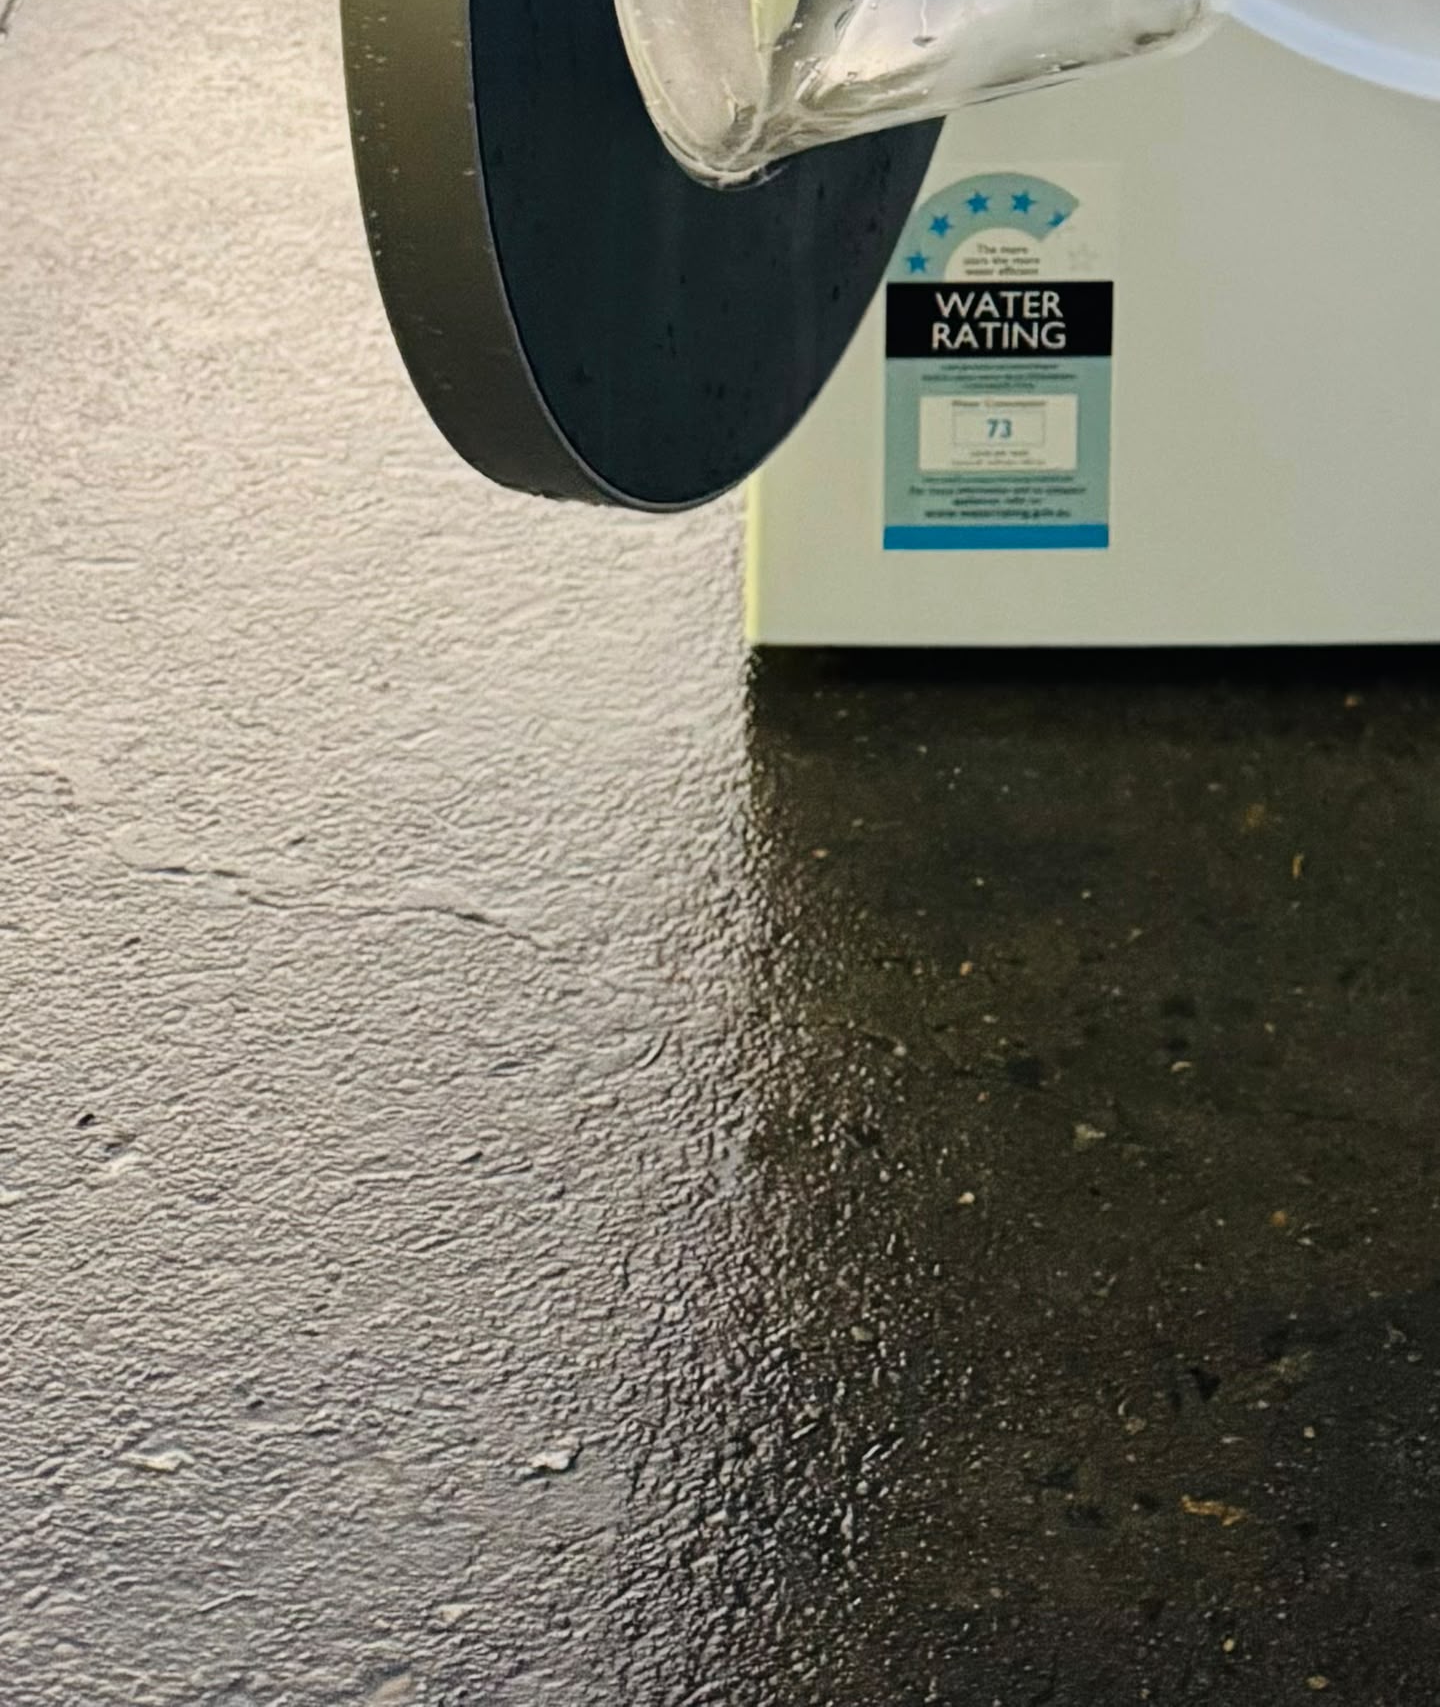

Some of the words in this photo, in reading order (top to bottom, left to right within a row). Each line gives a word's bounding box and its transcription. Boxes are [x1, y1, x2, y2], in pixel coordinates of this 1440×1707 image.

[935, 290, 1064, 320] WATER
[932, 320, 1067, 351] RATING
[986, 417, 1013, 440] 73
